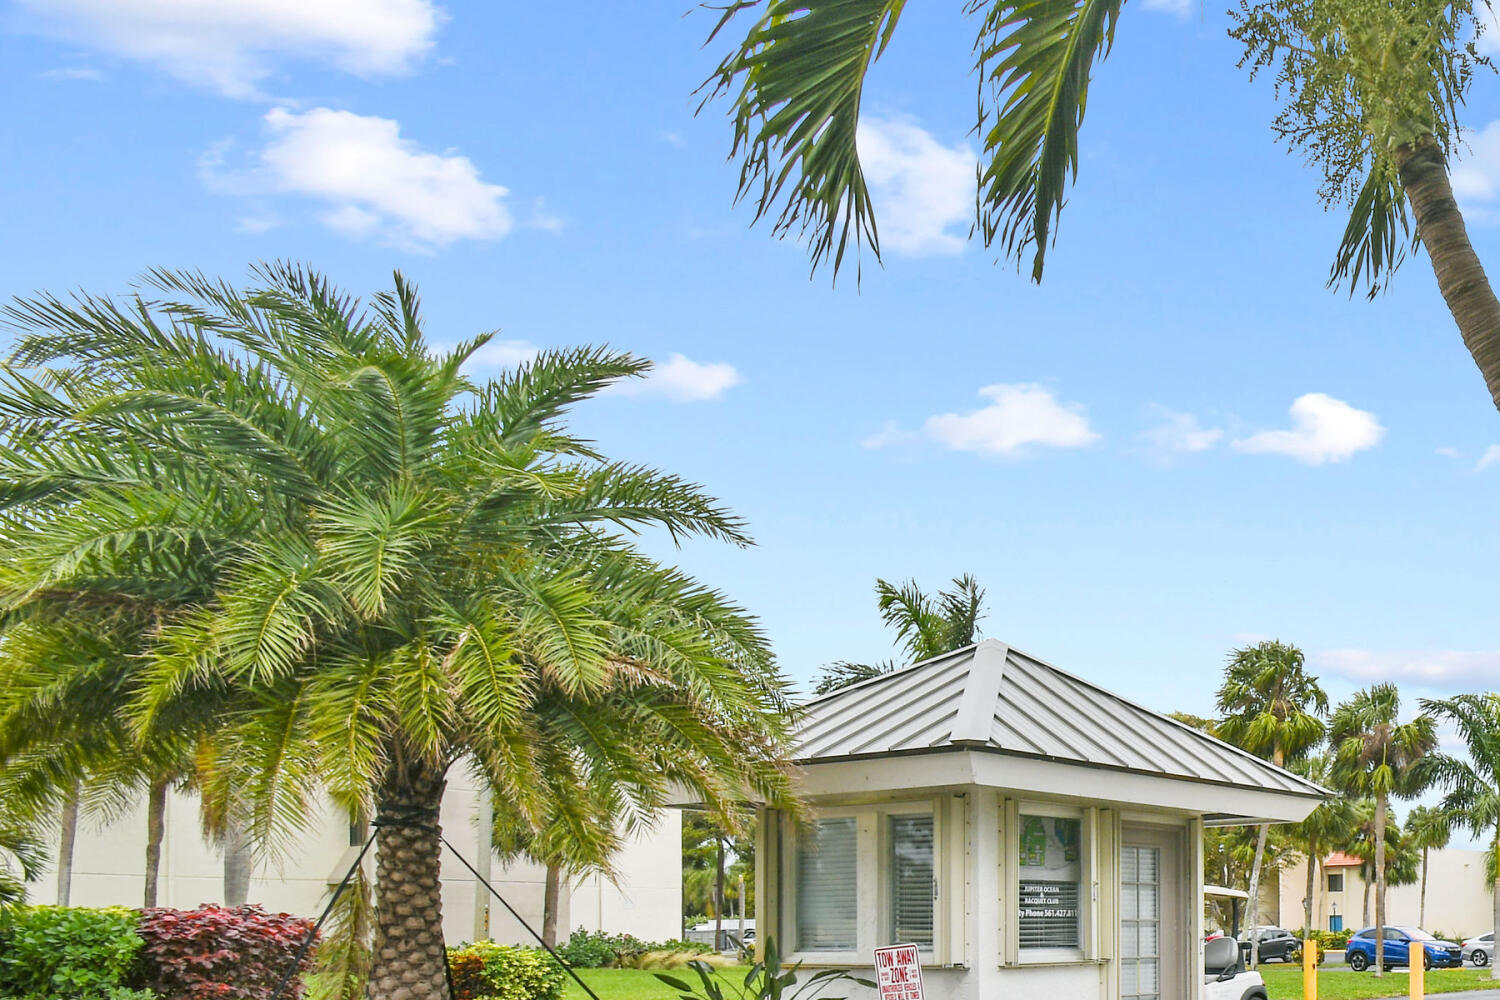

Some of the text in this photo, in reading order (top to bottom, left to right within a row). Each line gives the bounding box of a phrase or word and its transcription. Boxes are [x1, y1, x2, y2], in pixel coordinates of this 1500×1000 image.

[1024, 897, 1059, 905] RACQUET CLUB
[1025, 909, 1044, 917] Phone
[877, 948, 915, 968] TOW AWAY
[890, 966, 909, 983] ZONE
